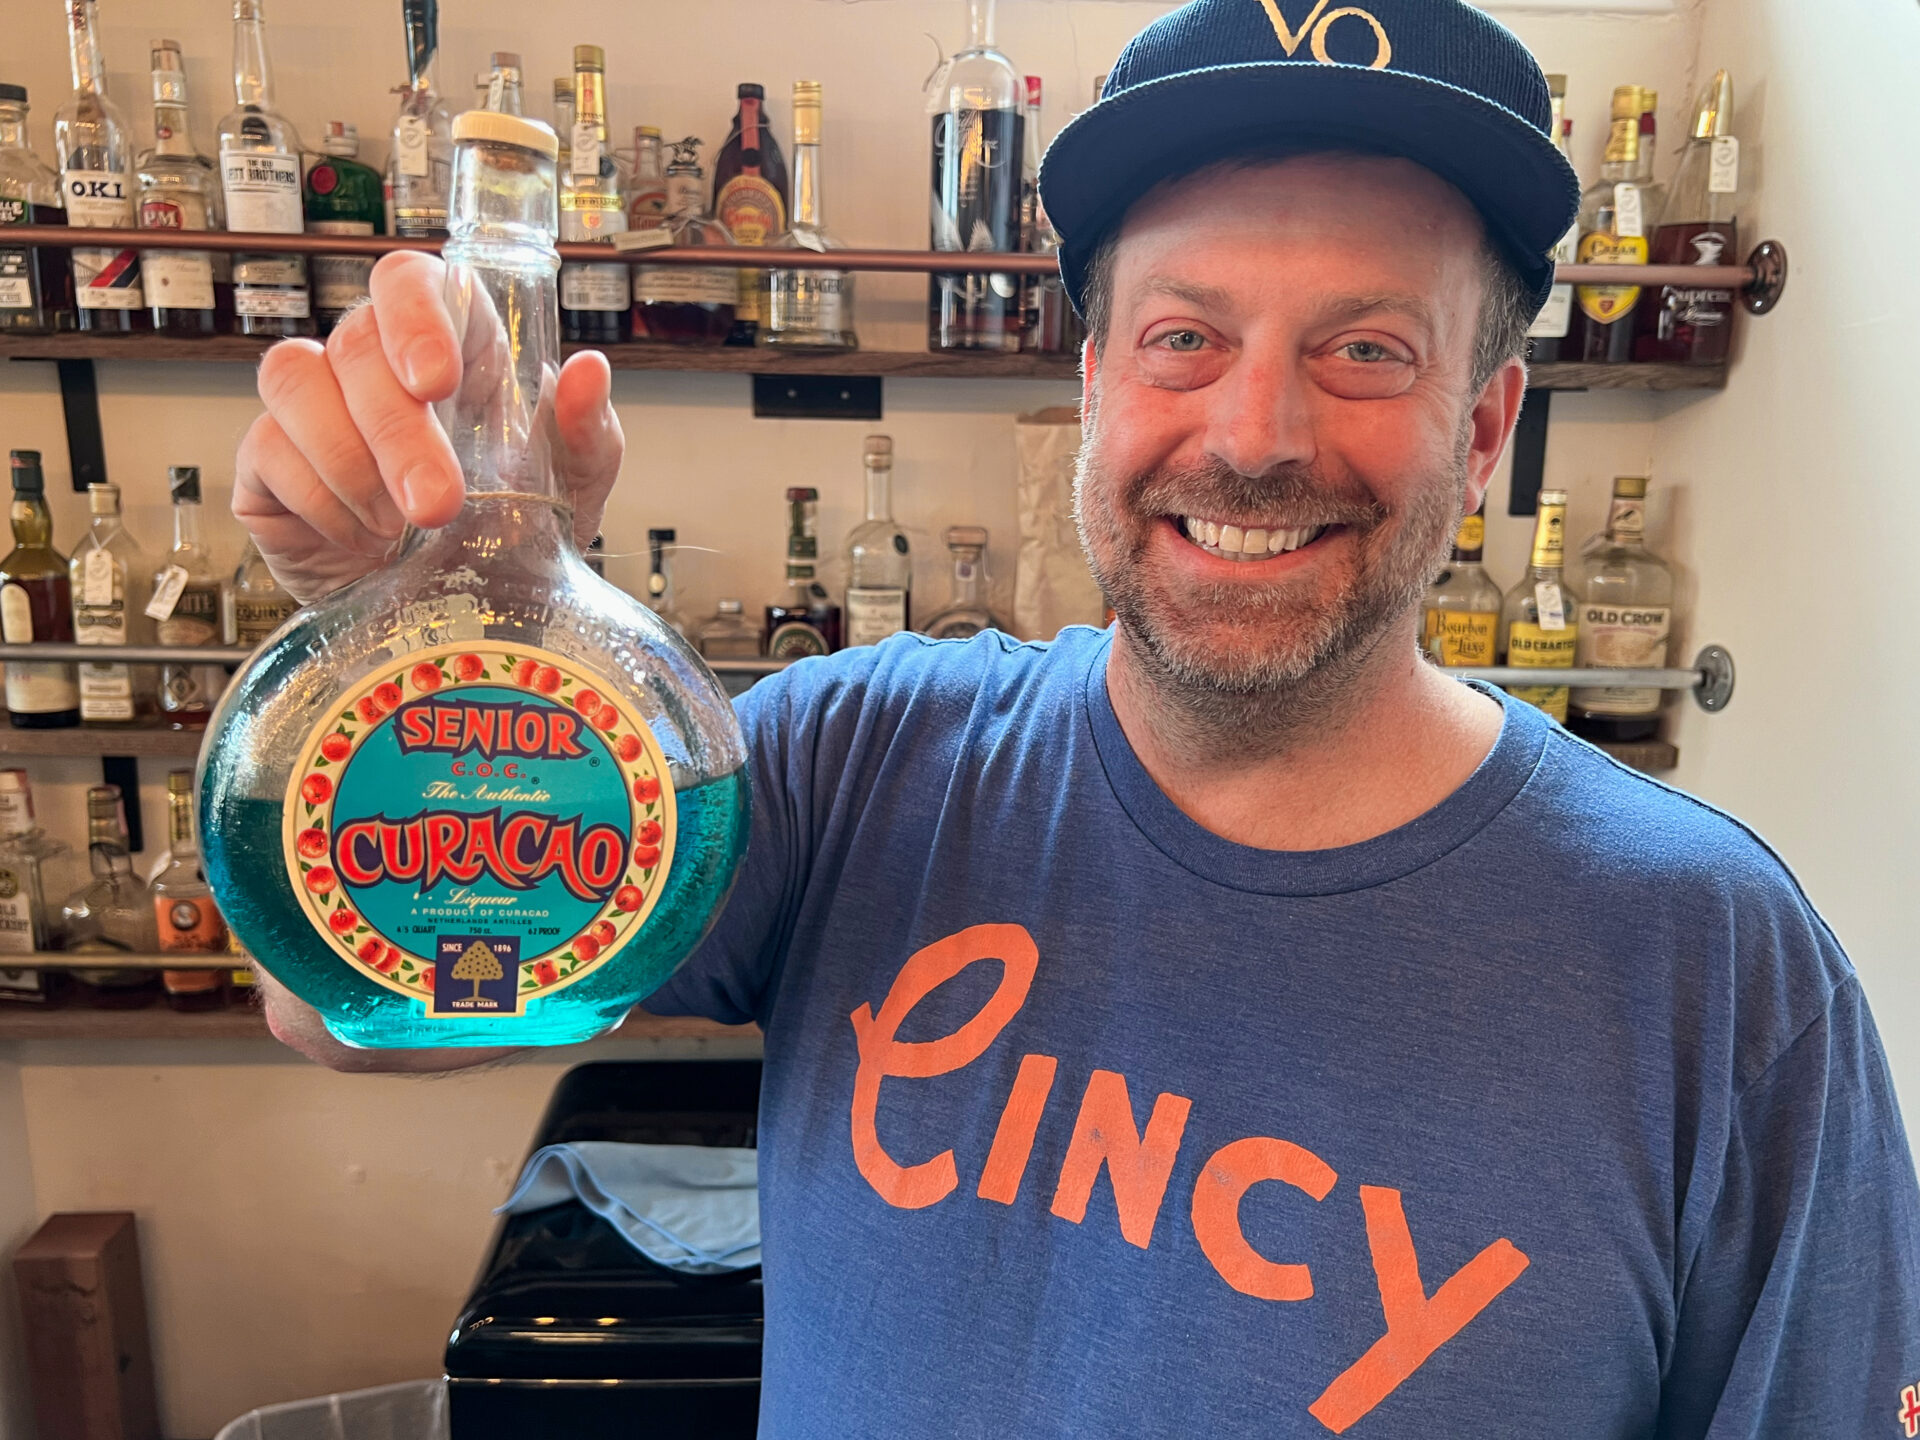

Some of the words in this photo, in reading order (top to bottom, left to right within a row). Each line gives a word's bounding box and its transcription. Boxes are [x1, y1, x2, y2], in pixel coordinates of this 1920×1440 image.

[1260, 0, 1391, 69] VO
[143, 209, 179, 227] PM
[1436, 611, 1487, 635] Bourbon
[1587, 609, 1618, 623] OLD
[1621, 611, 1664, 625] CROW
[1456, 637, 1486, 656] Luxe
[1511, 638, 1532, 649] OLD
[400, 705, 584, 756] SENIOR
[451, 761, 527, 779] C.O.C.
[422, 780, 459, 800] The
[461, 783, 551, 802] Authentic
[336, 813, 624, 900] CURACAO
[444, 887, 518, 910] Liqueur
[411, 907, 418, 915] A
[422, 907, 475, 916] PRODUCT
[480, 908, 494, 916] OF
[498, 908, 549, 918] CURACAO
[412, 925, 436, 934] QUART
[469, 926, 483, 934] 750
[493, 918, 532, 926] ANTILLES
[538, 927, 561, 936] PROOF
[442, 943, 463, 953] SINCE
[493, 944, 512, 953] 1896
[451, 1001, 474, 1009] TRADE
[477, 1001, 499, 1009] MARK
